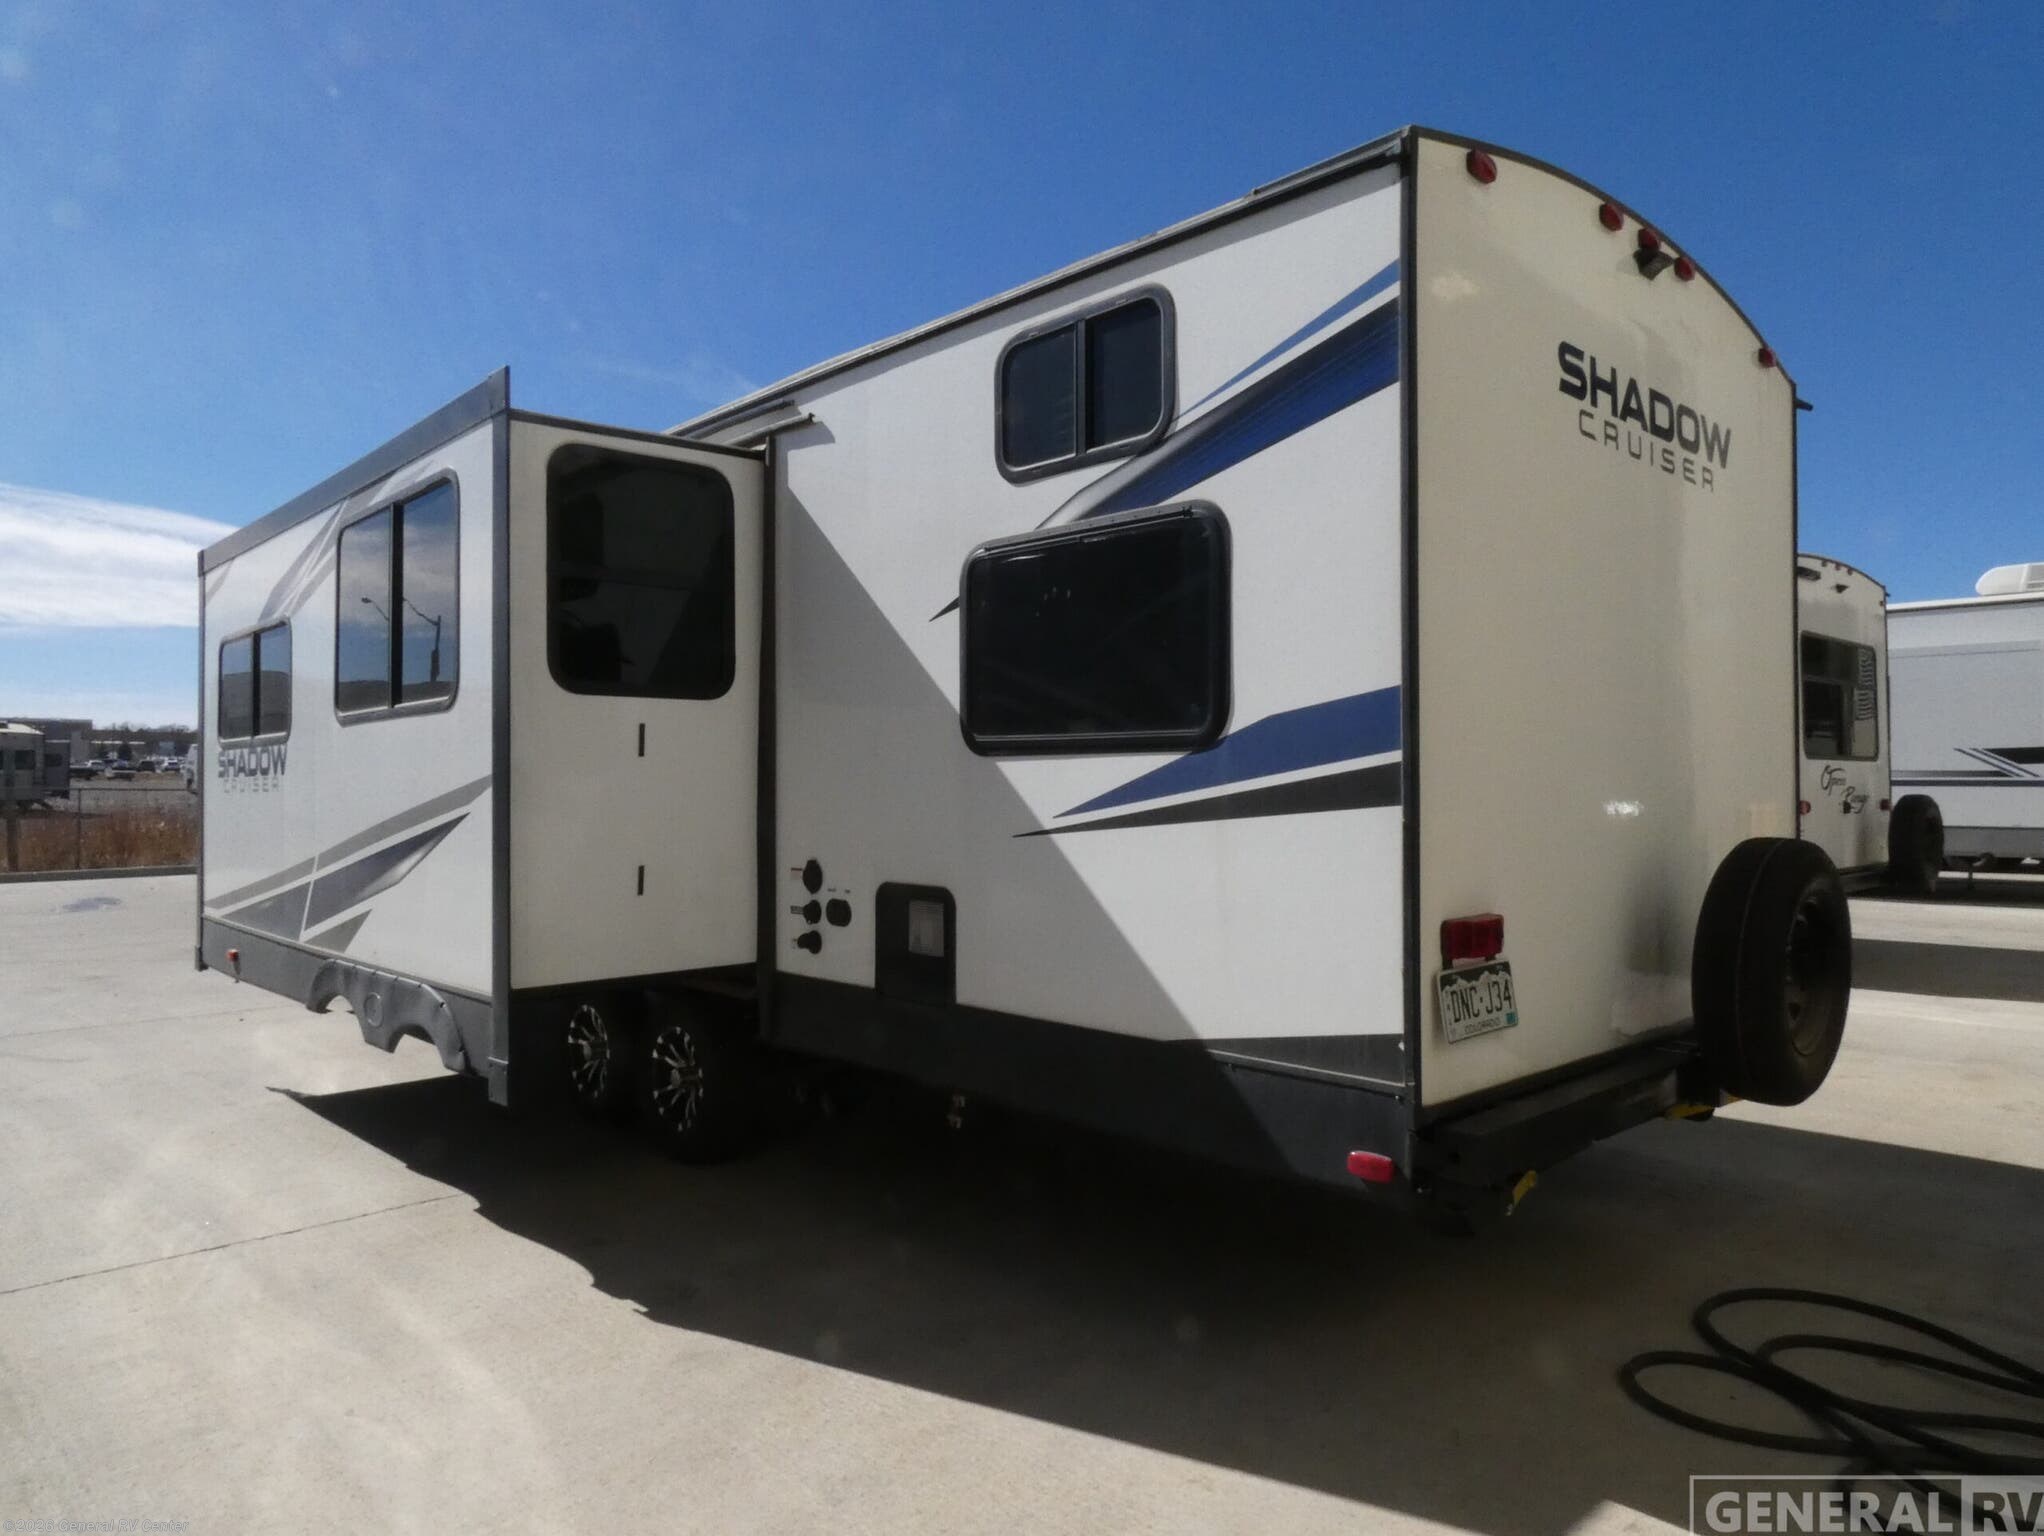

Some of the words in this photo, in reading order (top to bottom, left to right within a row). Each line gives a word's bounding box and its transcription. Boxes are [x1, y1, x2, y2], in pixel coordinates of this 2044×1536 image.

[1557, 340, 1731, 470] SHADOW
[1578, 408, 1715, 493] CRUISER
[217, 744, 288, 778] SHADOW
